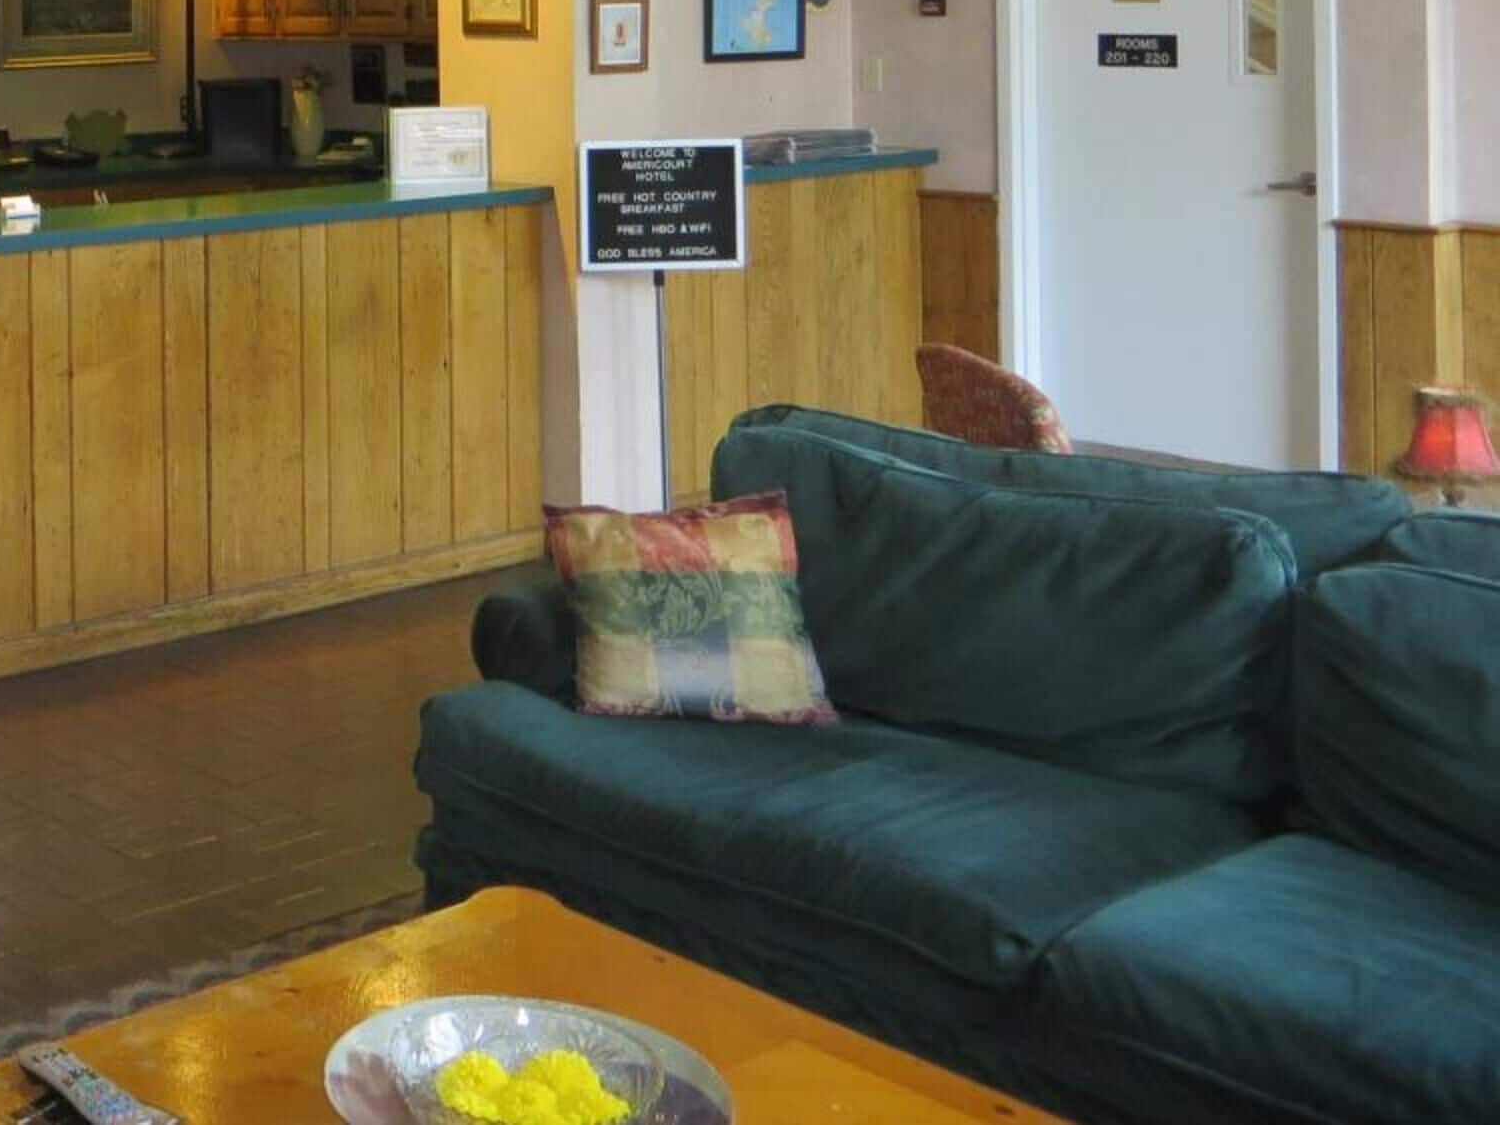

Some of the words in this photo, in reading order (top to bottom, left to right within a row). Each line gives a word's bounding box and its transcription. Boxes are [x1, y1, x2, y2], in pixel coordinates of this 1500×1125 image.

[1115, 38, 1159, 51] ROOMS
[620, 148, 676, 159] WELCOME
[684, 147, 696, 158] TO
[635, 172, 675, 182] HOTEL
[597, 192, 627, 204] FREE
[633, 192, 656, 202] HOT
[663, 190, 718, 202] COUNTRY
[620, 203, 685, 215] BREAKFAST
[616, 224, 645, 235] FREE
[597, 248, 622, 260] GOD
[627, 247, 663, 259] BLESS
[669, 246, 718, 257] AMERICA
